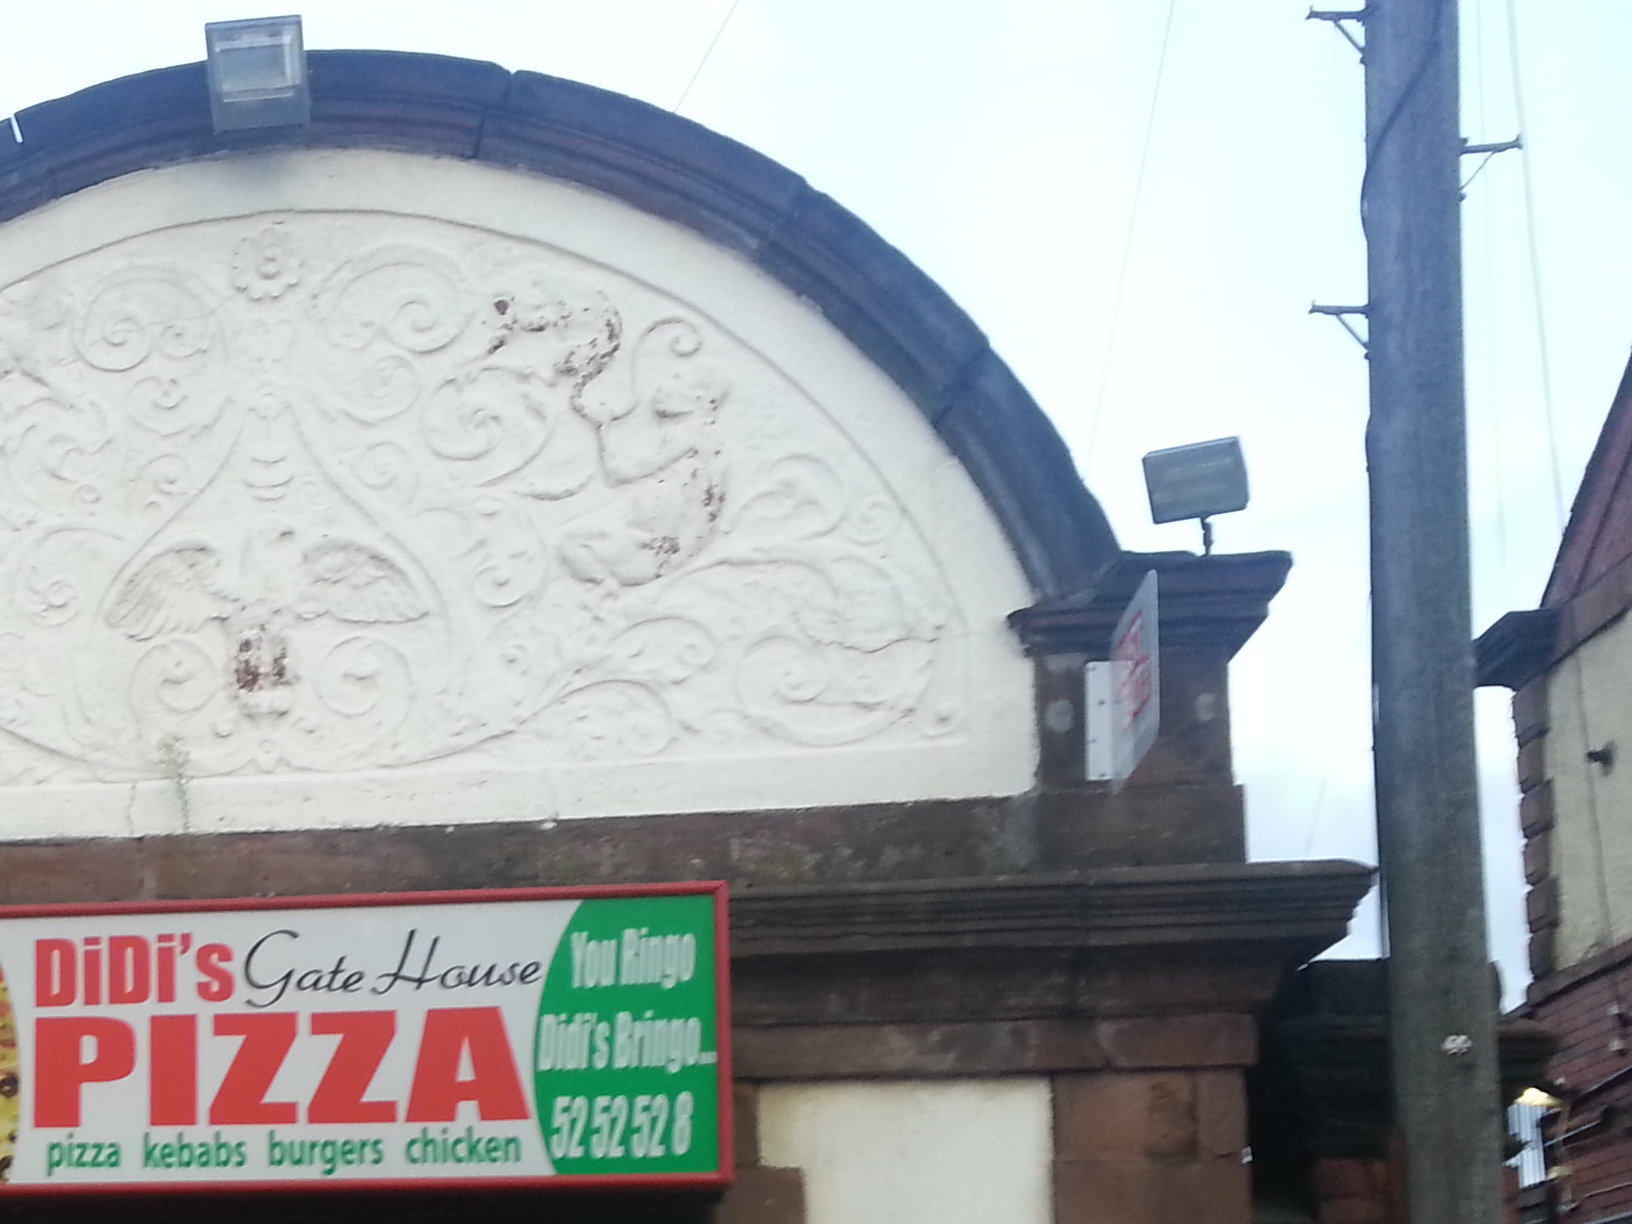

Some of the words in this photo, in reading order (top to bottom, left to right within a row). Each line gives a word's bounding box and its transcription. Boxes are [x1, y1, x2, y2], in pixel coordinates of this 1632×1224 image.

[244, 929, 364, 1008] Gate
[371, 928, 543, 995] House
[571, 931, 617, 988] You
[620, 927, 696, 989] Ringo
[33, 1006, 531, 1128] PIZZA
[47, 1132, 121, 1177] pizza
[143, 1130, 246, 1168] kebabs
[268, 1129, 384, 1175] burgers
[405, 1126, 522, 1164] chicken
